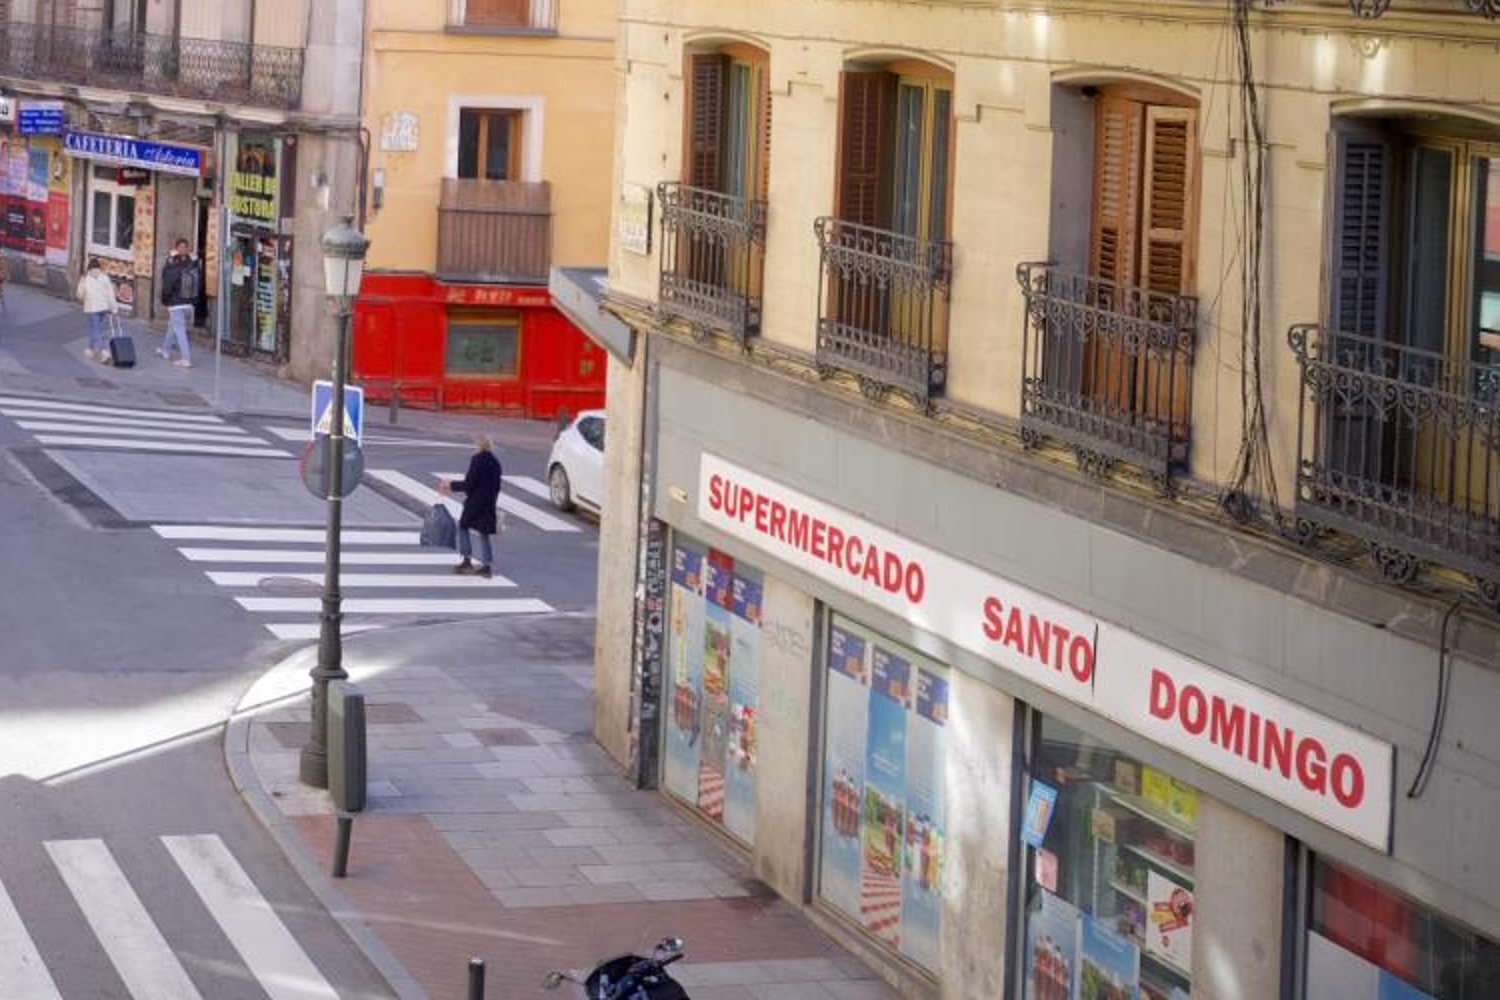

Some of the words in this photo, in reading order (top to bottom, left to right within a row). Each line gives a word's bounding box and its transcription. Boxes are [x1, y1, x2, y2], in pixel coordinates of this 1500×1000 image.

[708, 475, 926, 604] SUPERMERCADO
[982, 596, 1094, 685] SANTO
[1149, 668, 1365, 809] DOMINGO
